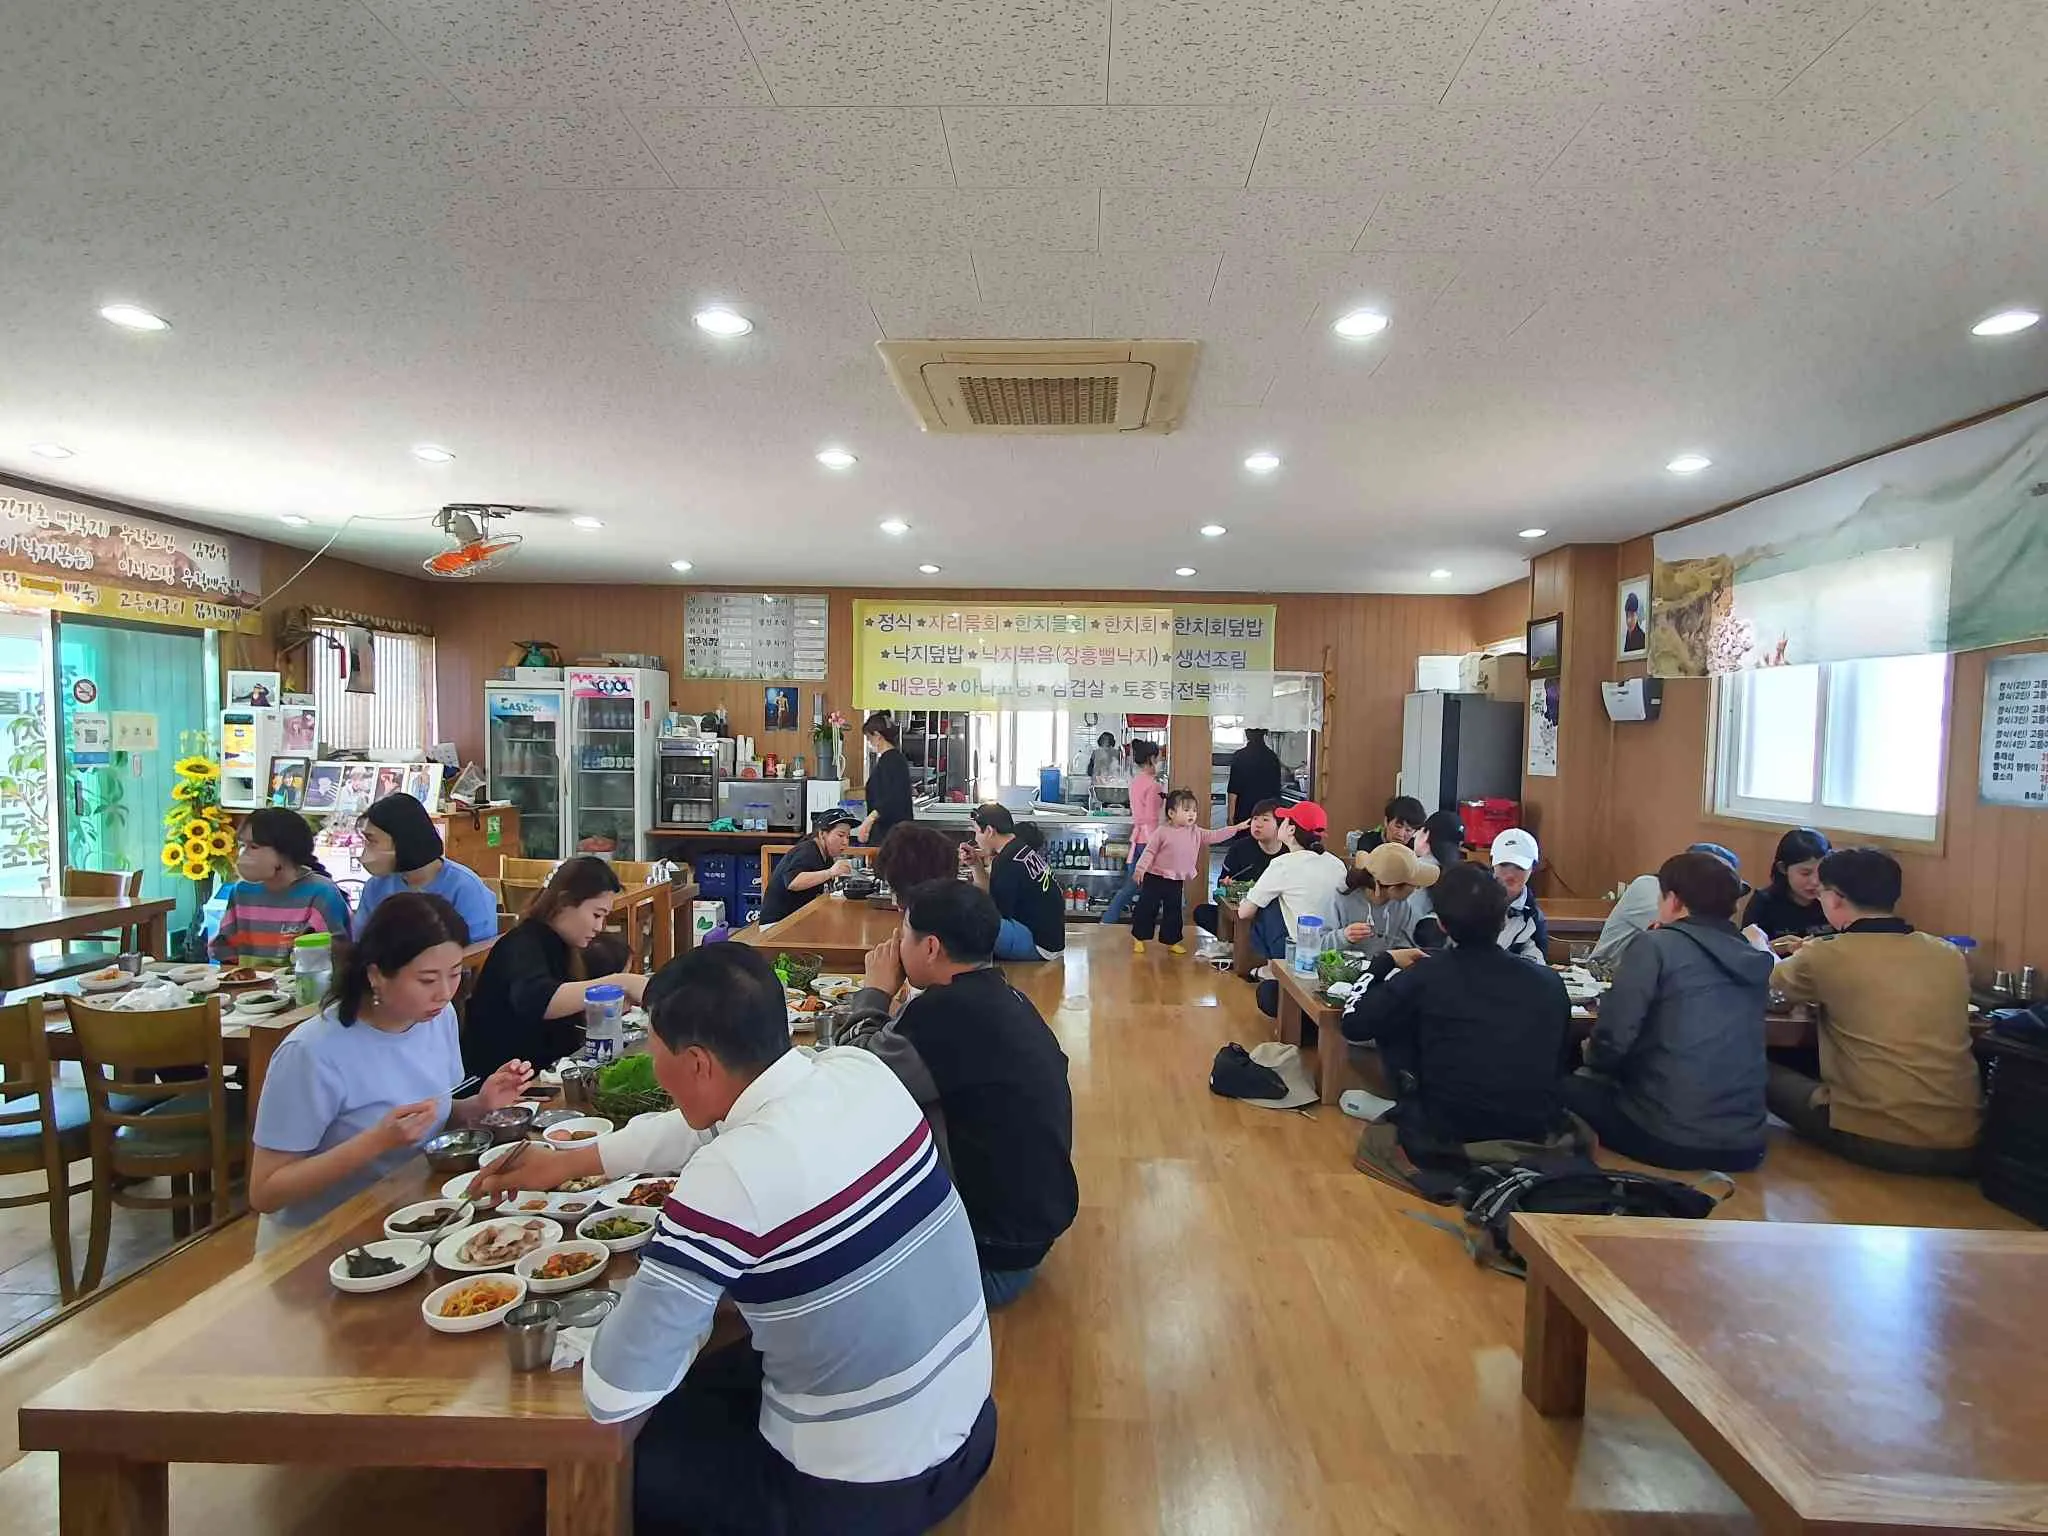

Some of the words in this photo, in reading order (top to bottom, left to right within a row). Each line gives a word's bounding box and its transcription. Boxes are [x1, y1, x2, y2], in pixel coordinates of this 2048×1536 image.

[119, 592, 185, 615] 고등어구이
[878, 613, 912, 632] 정식
[928, 614, 999, 632] 자리물회
[1014, 615, 1086, 633] 한치물회
[1104, 616, 1157, 634] 한치회
[1174, 617, 1264, 637] 한치회덮밥
[893, 645, 963, 664] 낙지덮밥
[1175, 649, 1247, 669] 생선조림
[891, 678, 943, 696] 매운탕
[1051, 679, 1105, 698] 삼겹살
